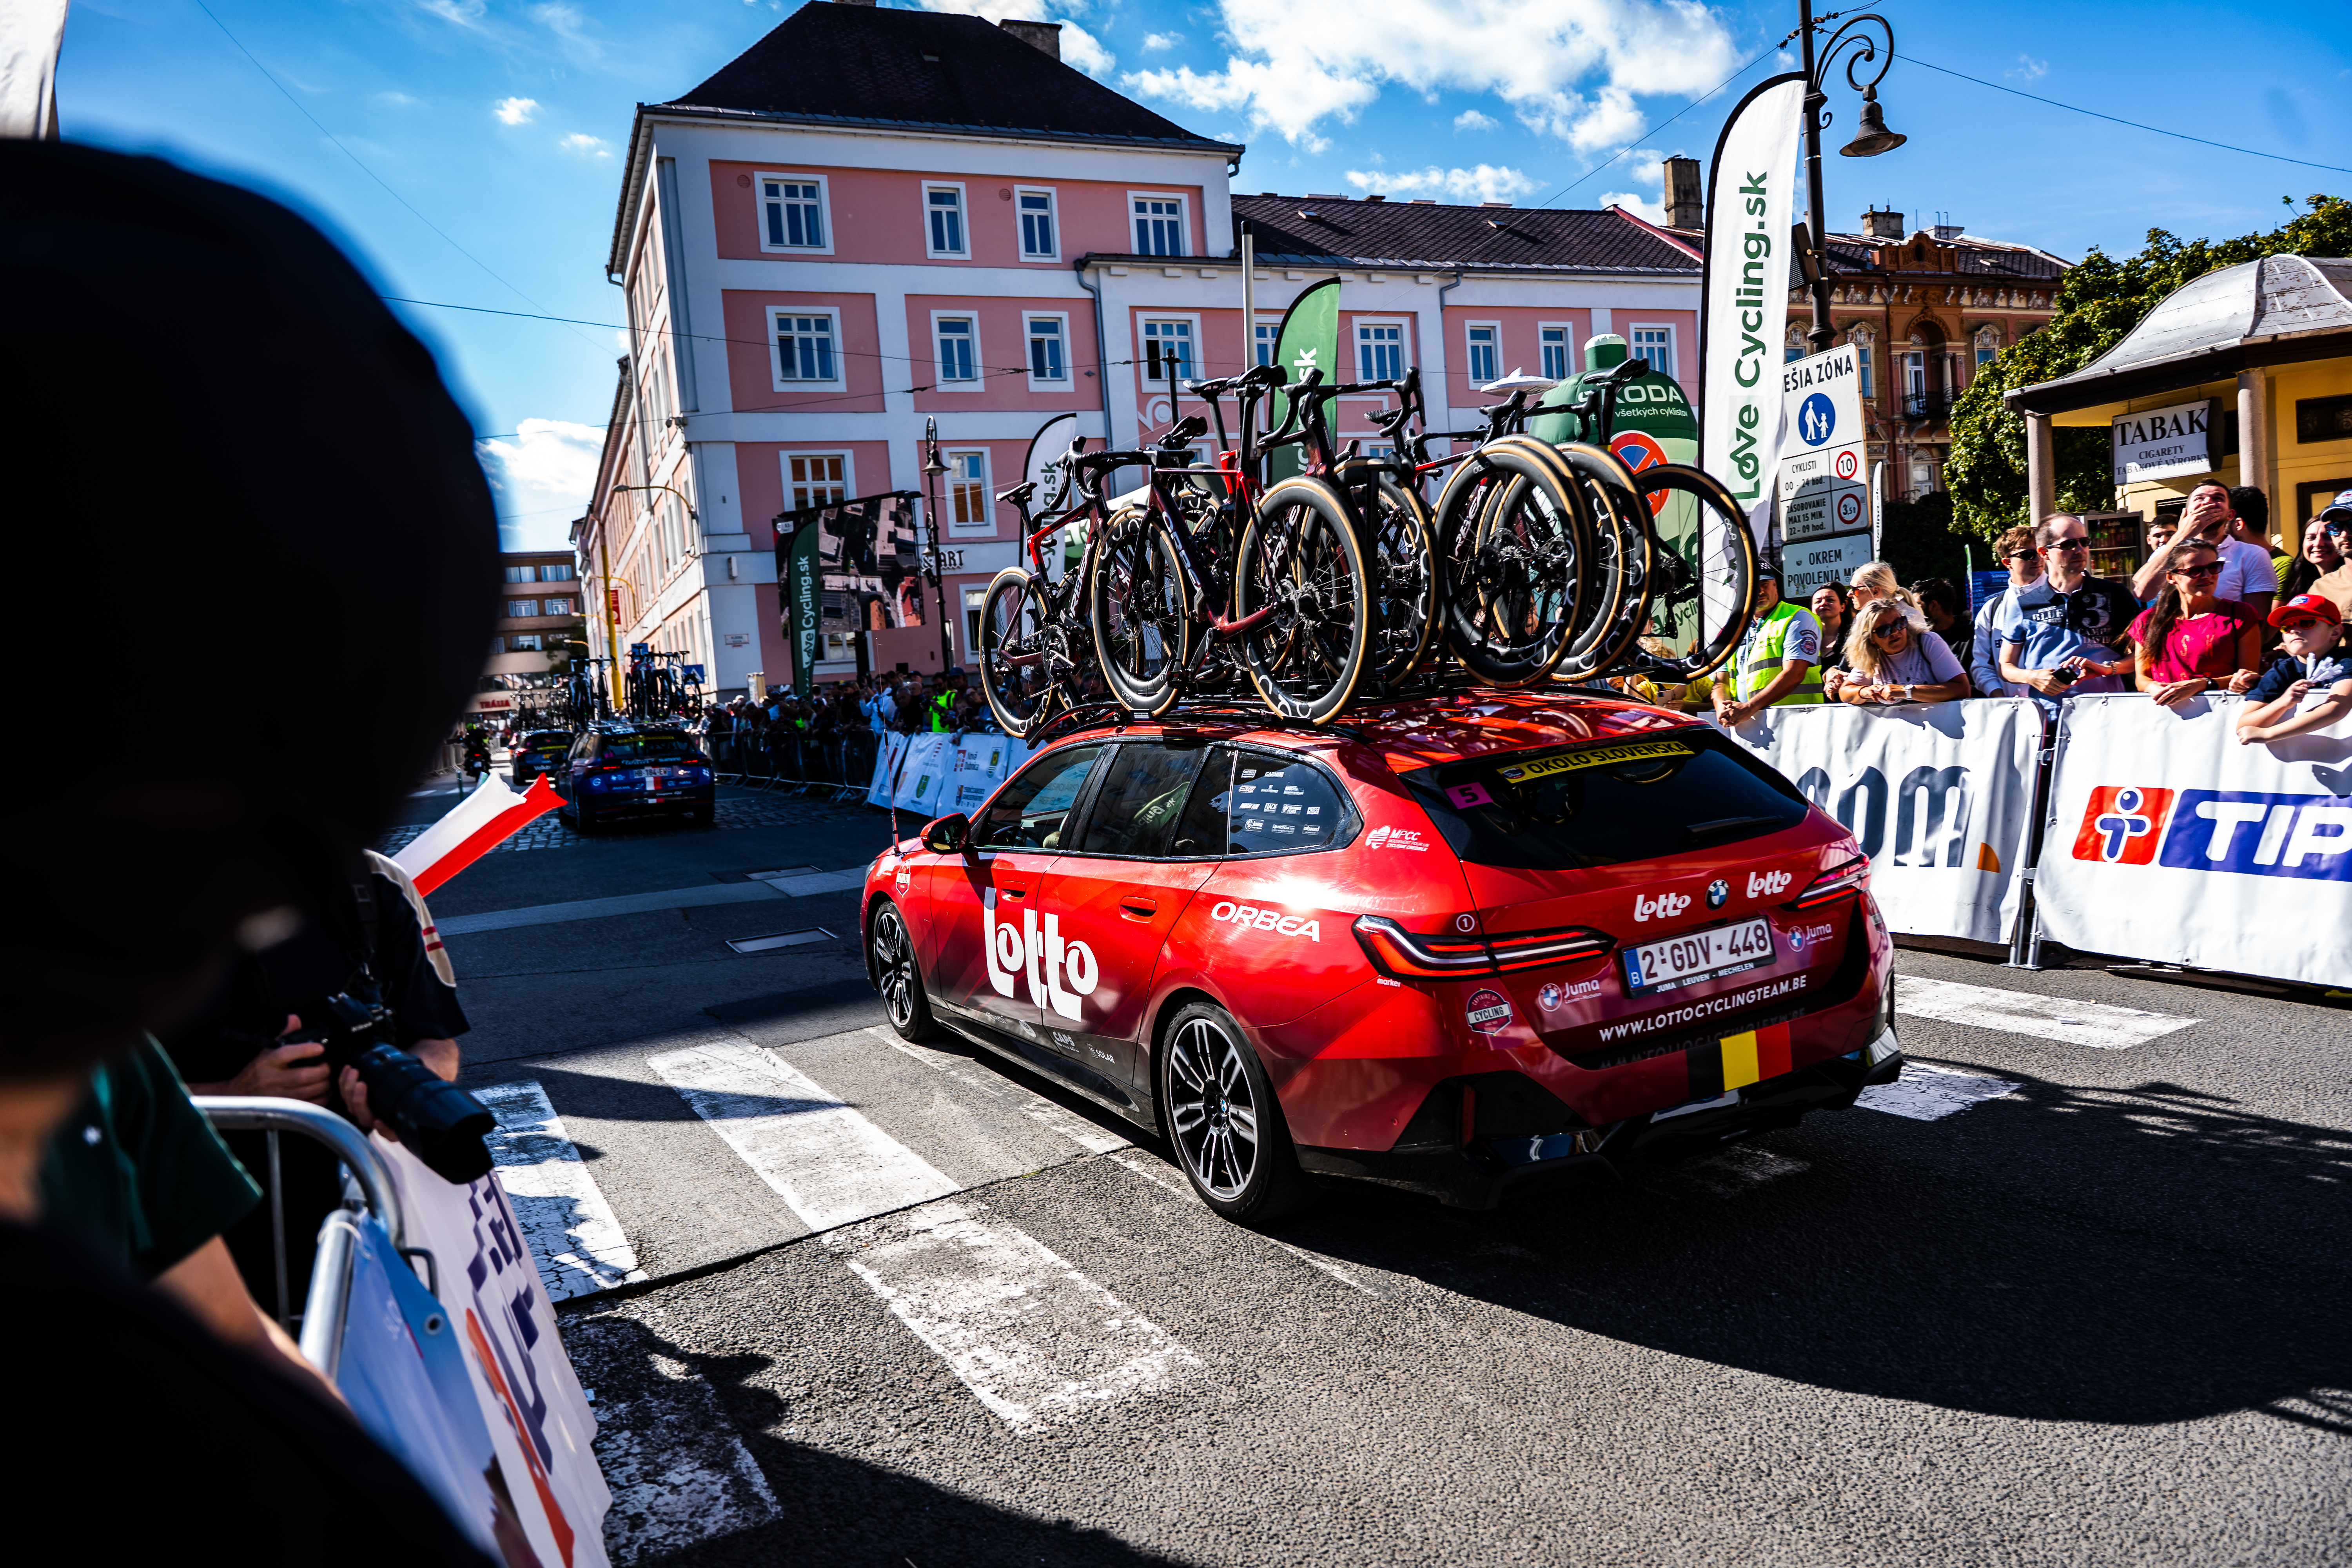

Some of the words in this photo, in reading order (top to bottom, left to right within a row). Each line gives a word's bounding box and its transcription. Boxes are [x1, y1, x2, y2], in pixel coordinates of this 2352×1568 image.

[1735, 171, 1771, 387] Cycling.sk
[1784, 367, 1813, 392] EŠIA
[1816, 355, 1854, 383] ZÓNA
[1615, 407, 1658, 422] všetkých
[2114, 407, 2208, 446] TABAK
[2139, 445, 2185, 460] CIGARETY
[1792, 460, 1817, 474] CYKLISTI
[1841, 458, 1852, 473] 10
[2116, 457, 2162, 475] TABAKOVÉ
[2166, 453, 2209, 466] VÝROBKY
[1785, 481, 1793, 490] 00
[1802, 479, 1809, 488] 24
[1812, 475, 1825, 486] hod.
[1786, 498, 1826, 514] ZÁSOBOVANIE
[1788, 514, 1801, 524] MAX
[1802, 513, 1809, 522] 15
[1811, 510, 1825, 520] MIN.
[1789, 527, 1796, 535] 22
[1802, 524, 1809, 533] 09
[1811, 522, 1826, 532] hod.
[1809, 549, 1842, 565] OKREM
[1788, 569, 1840, 587] POVOLENIA
[797, 555, 815, 628] Cycling.sk
[2082, 593, 2110, 628] 3
[1528, 754, 1591, 775] OKOLO
[1594, 741, 1688, 762] SLOVENSKA
[1461, 786, 1479, 804] 5
[1389, 829, 1421, 841] MPCC
[1210, 901, 1320, 942] ORBEA
[1806, 924, 1832, 940] Juma
[1377, 975, 1401, 987] marker
[1631, 971, 1639, 985] B
[1656, 983, 1677, 993] JUMA
[1682, 973, 1710, 986] LEUVEN
[1718, 962, 1754, 976] MECHELEN
[1564, 980, 1600, 999] Juma
[1474, 1006, 1504, 1021] CYCLING
[1599, 975, 1807, 1042] WWW.LOTTOCYCLINGTEAM.BE
[1053, 1031, 1075, 1047] CAPS
[1096, 1048, 1116, 1064] SOLAR
